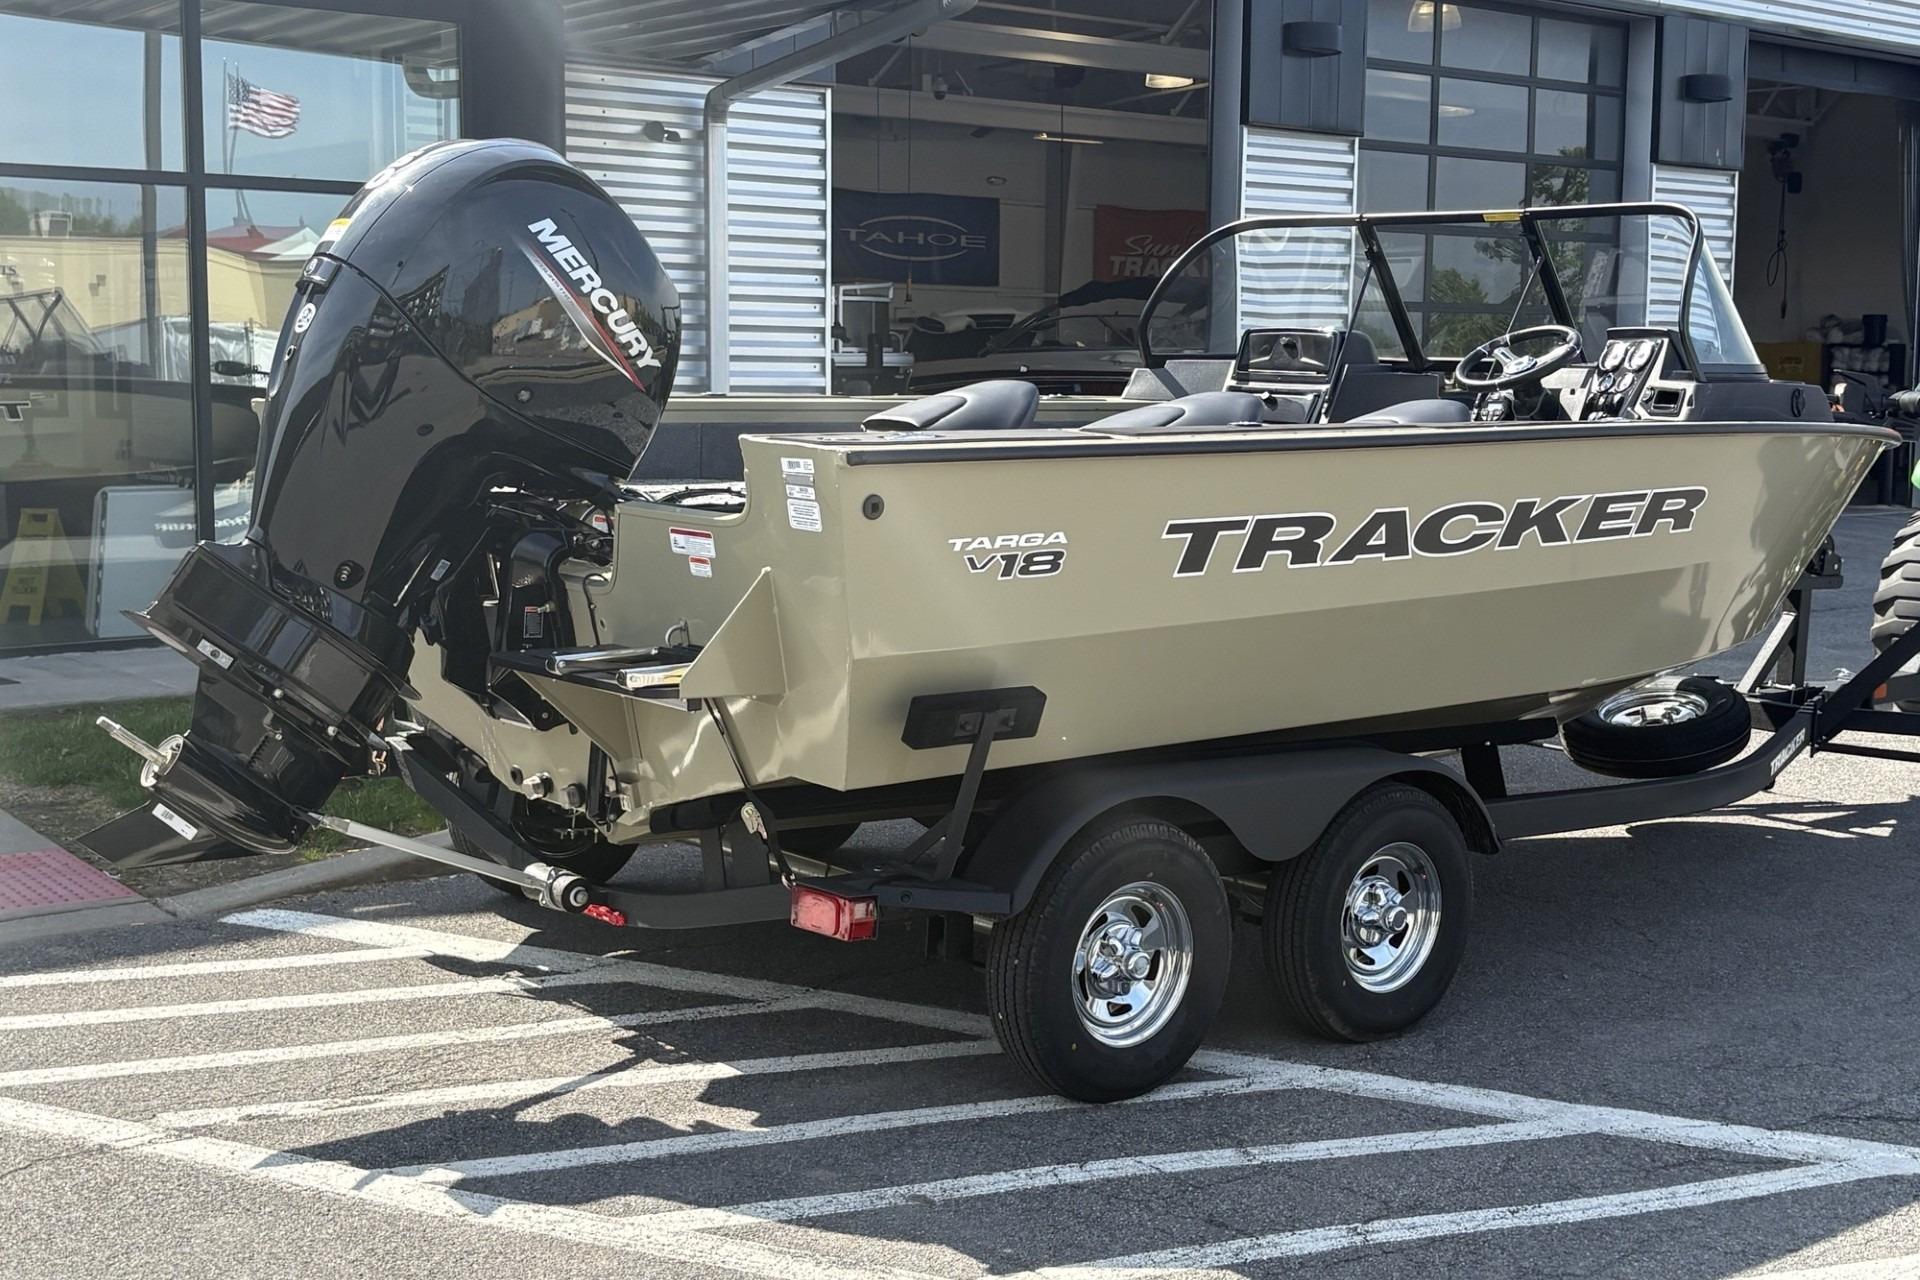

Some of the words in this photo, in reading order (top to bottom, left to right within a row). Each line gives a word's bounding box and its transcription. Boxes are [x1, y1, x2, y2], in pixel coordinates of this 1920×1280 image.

[839, 227, 987, 249] TAHOE
[527, 217, 662, 369] MERCURY
[948, 531, 1068, 551] TARGA
[1161, 486, 1708, 578] TRACKER
[964, 548, 1067, 580] V18
